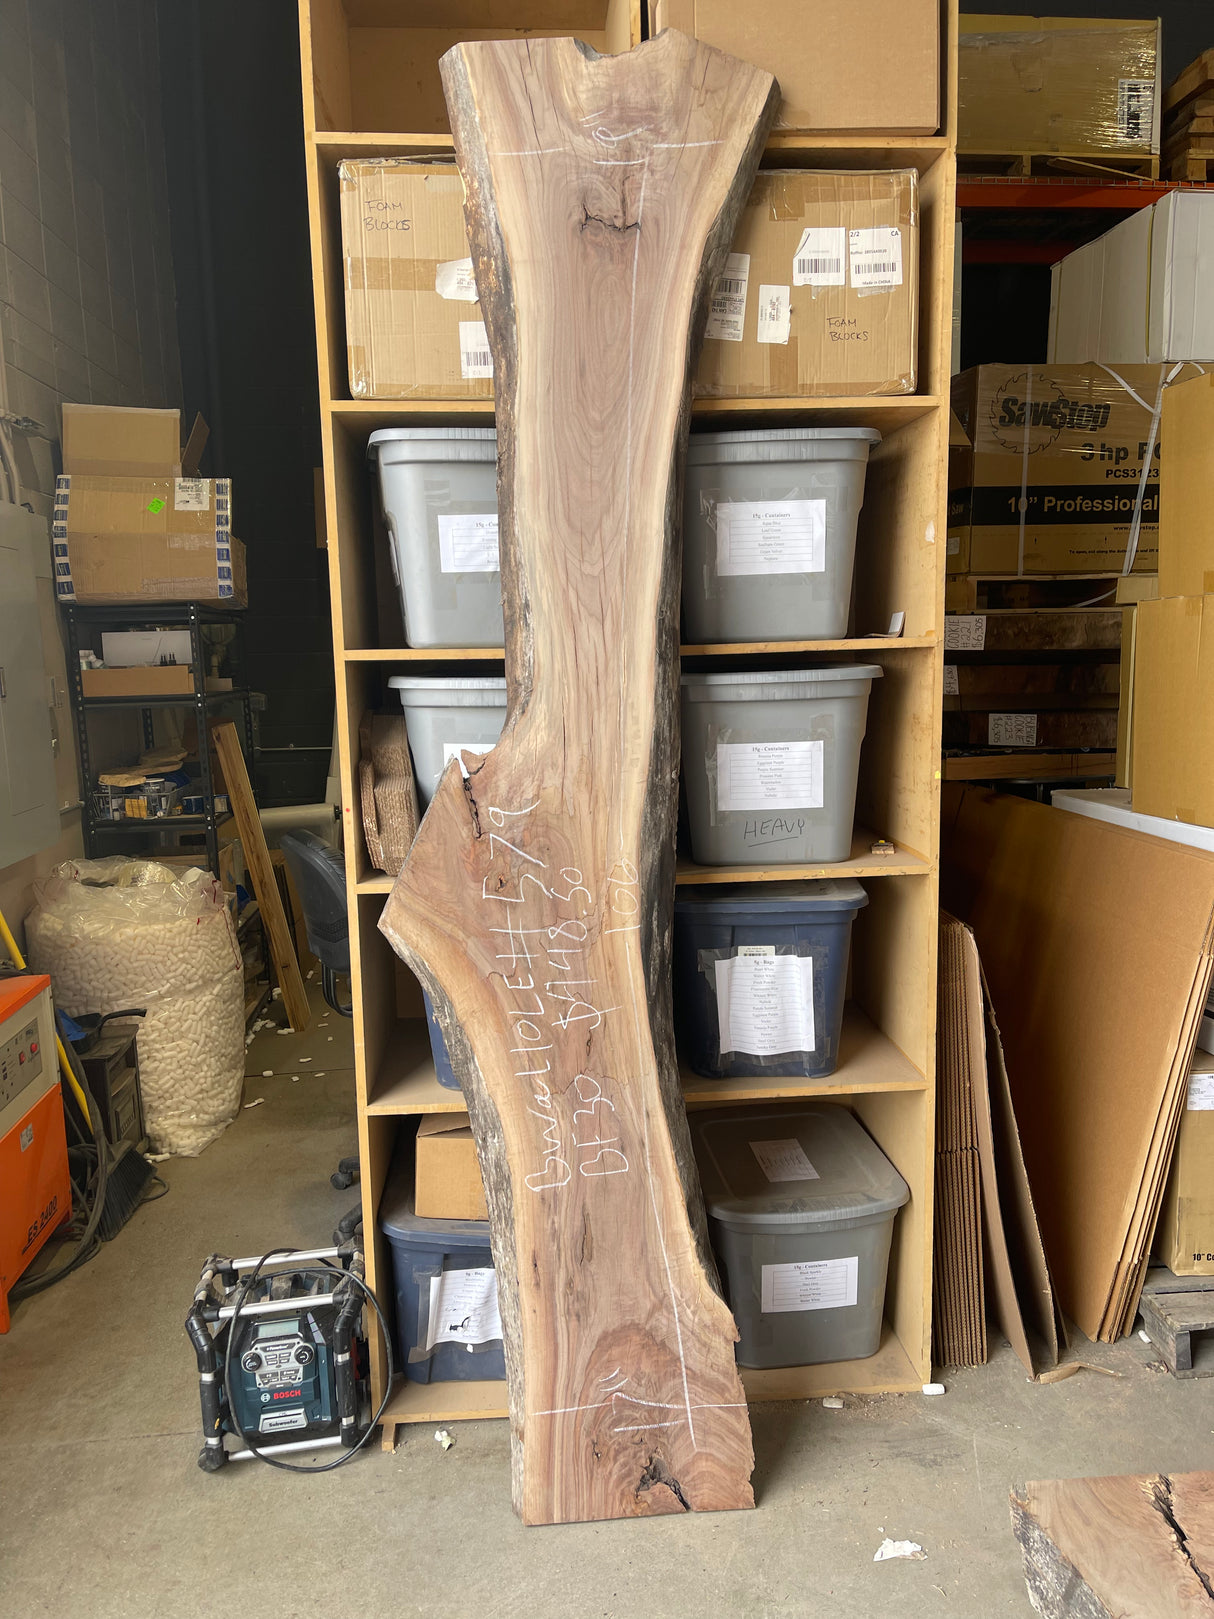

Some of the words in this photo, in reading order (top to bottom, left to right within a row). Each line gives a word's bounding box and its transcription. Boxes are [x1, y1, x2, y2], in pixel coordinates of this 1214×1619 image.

[364, 199, 403, 212] FOAM
[826, 316, 857, 328] FOAM
[829, 331, 869, 341] BLOCKS
[999, 395, 1111, 432] SawStop
[1080, 443, 1095, 461] 3
[1100, 443, 1129, 465] hp
[947, 619, 960, 649] COOKIE
[743, 817, 805, 840] HEAVY
[273, 1389, 302, 1400] BOSCH
[268, 1419, 299, 1428] Subwoofer
